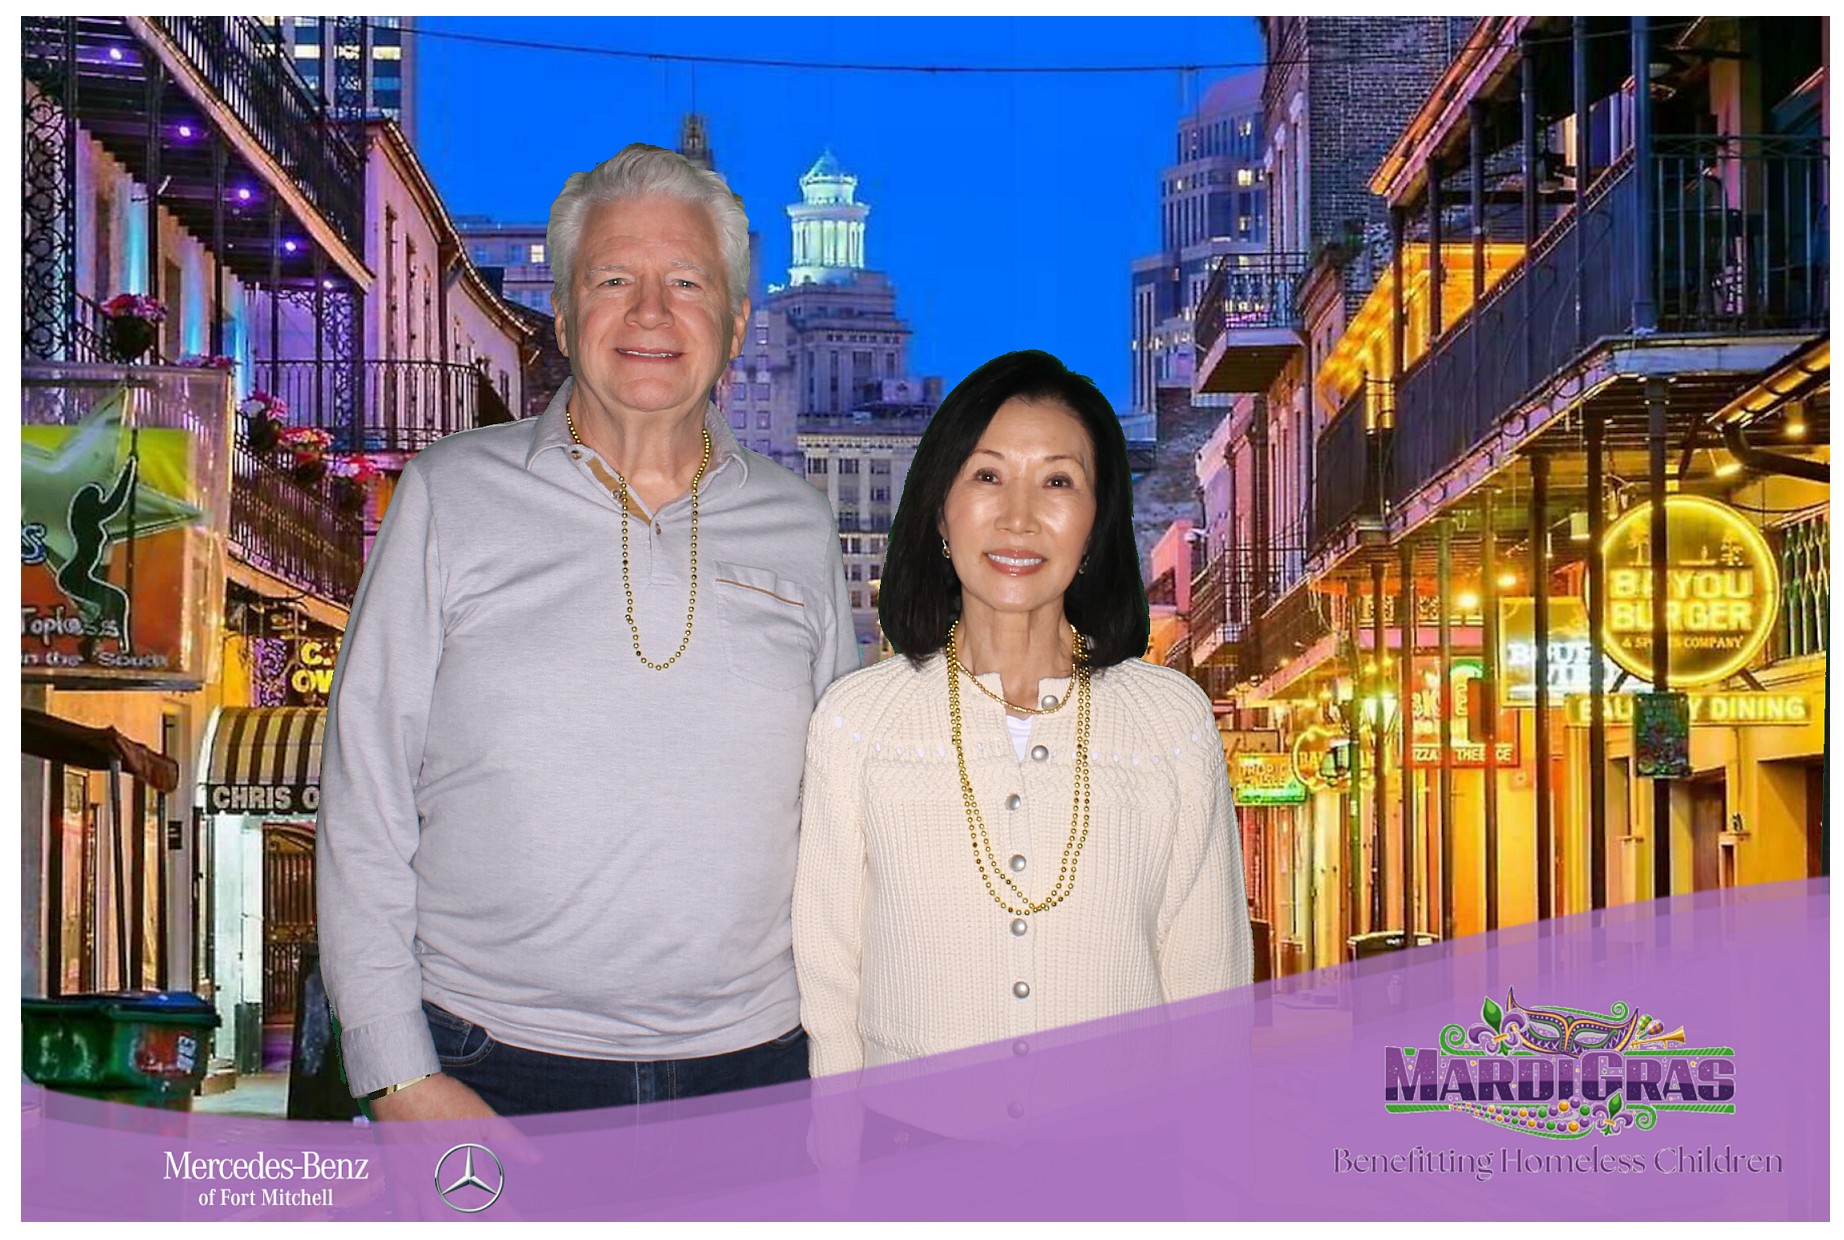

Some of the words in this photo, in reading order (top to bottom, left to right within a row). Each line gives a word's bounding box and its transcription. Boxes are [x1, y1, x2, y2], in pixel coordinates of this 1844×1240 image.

[1684, 635, 1743, 649] COMPANY
[1709, 696, 1806, 720] DINING
[213, 785, 292, 810] CHRIS
